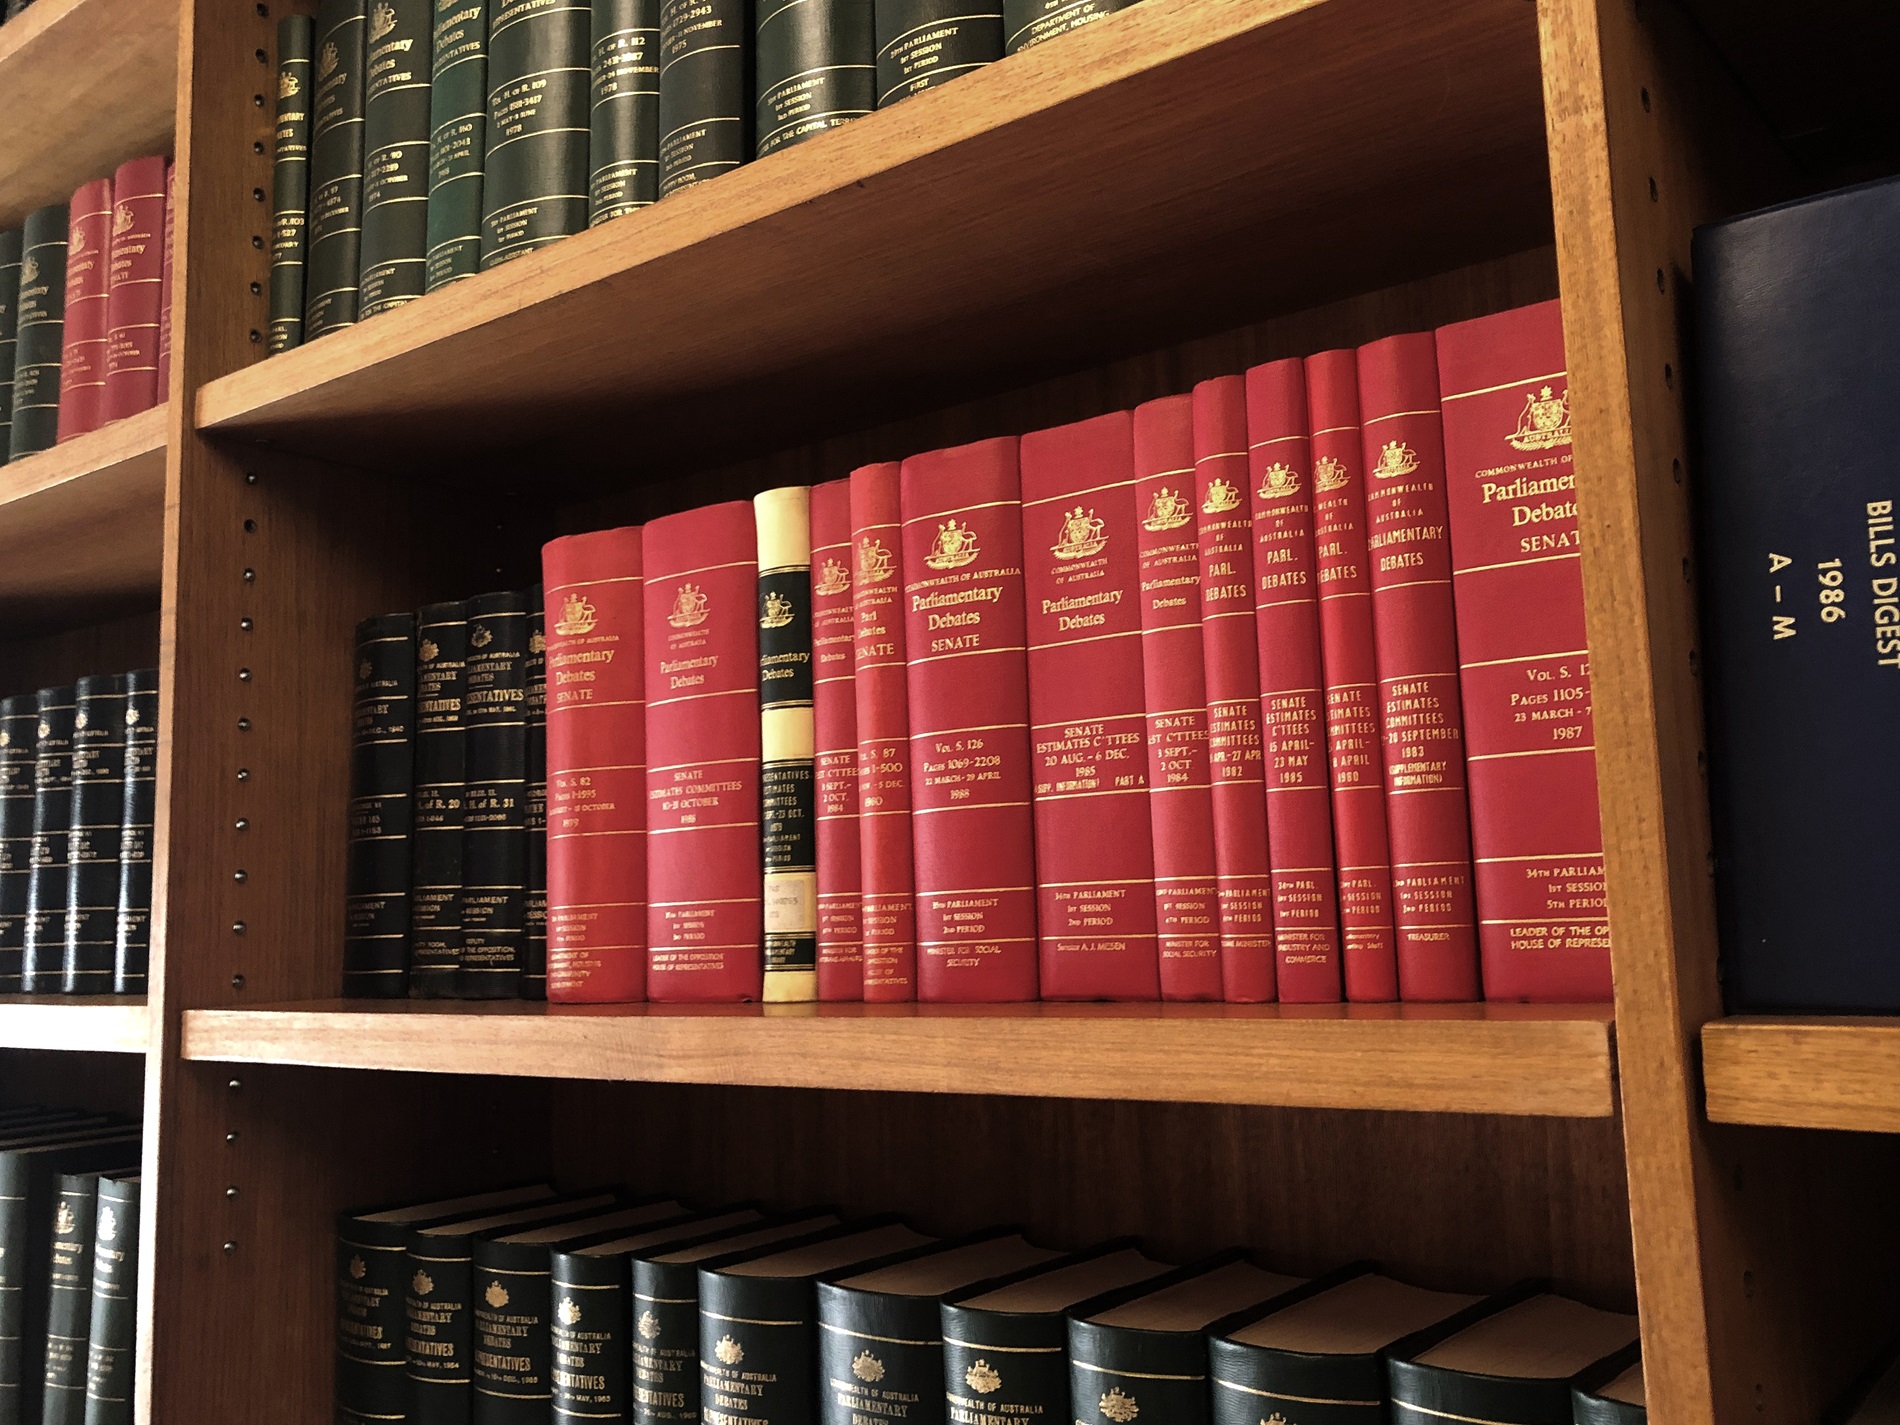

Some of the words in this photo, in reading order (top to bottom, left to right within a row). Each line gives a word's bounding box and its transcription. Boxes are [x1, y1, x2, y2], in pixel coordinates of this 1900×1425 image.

[1032, 8, 1081, 35] DEPARTMENT
[1084, 3, 1095, 13] OF
[684, 20, 722, 34] NOVEMBER
[904, 27, 958, 50] PARLIAMENT
[672, 39, 686, 54] 1975
[911, 42, 942, 59] SESSION
[914, 55, 938, 69] PERIOD
[778, 77, 825, 100] PARLIAMENT
[784, 92, 812, 107] SESSION
[796, 121, 827, 135] CAPITAL
[1475, 457, 1558, 478] COMMONWEALTH
[1561, 454, 1573, 463] OF
[1392, 498, 1401, 507] OF
[1325, 512, 1333, 521] OF
[1376, 508, 1423, 524] AUSTRALIA
[1275, 519, 1283, 528] OF
[1216, 534, 1224, 542] OF
[1260, 529, 1305, 543] AUSTRALIA
[1866, 500, 1897, 567] BILLS
[1204, 544, 1243, 556] AUSTRALIA
[1267, 549, 1298, 564] PARL.
[1319, 542, 1348, 559] PARL.
[1051, 558, 1108, 575] COMMONWEALTH
[1154, 554, 1198, 568] AUSTRALIA
[1380, 552, 1424, 572] DEBATES
[1768, 553, 1793, 573] A
[961, 573, 970, 581] OF
[973, 568, 1021, 579] AUSTRALIA
[1068, 570, 1105, 582] AUSTRALIA
[1209, 562, 1236, 578] PARL.
[1141, 575, 1201, 592] Parliamentary
[1262, 571, 1307, 590] DEBATES
[1205, 585, 1247, 602] DEBATES
[1817, 558, 1846, 623] 1986
[912, 586, 1003, 612] Parliamentary
[1042, 589, 1123, 614] Parliamentary
[1153, 597, 1186, 610] Debates
[928, 612, 980, 631] Debates
[1059, 613, 1105, 631] Debates
[1772, 615, 1797, 640] M
[1872, 577, 1900, 669] DIGEST
[931, 634, 979, 652] SENATE
[556, 671, 595, 685] Debates
[1560, 666, 1571, 678] S.
[1392, 682, 1429, 697] SENATE
[1271, 697, 1306, 710] SENATE
[1387, 697, 1440, 713] ESTIMATES
[1214, 705, 1247, 718] SENATE
[1266, 710, 1317, 725] ESTIMATES
[1514, 712, 1526, 723] 23
[1532, 708, 1573, 720] MARCH
[1155, 716, 1195, 728] SENATE
[1385, 712, 1444, 729] COMMITTEES
[1064, 724, 1104, 738] SENATE
[1402, 728, 1459, 742] SEPTEMBER
[1553, 726, 1583, 740] 1987
[967, 739, 984, 749] 126
[1037, 738, 1090, 753] ESTIMATES
[1269, 742, 1277, 753] 15
[883, 748, 896, 758] 87
[1045, 756, 1057, 766] 20
[1095, 751, 1102, 761] 6
[1105, 748, 1129, 760] DEC.
[1401, 746, 1424, 758] 1983
[948, 756, 1001, 769] 1069-2208
[1274, 757, 1284, 768] 23
[1288, 755, 1308, 767] MAY
[1341, 754, 1370, 766] APRIL
[674, 770, 702, 781] SENATE
[967, 773, 975, 782] 29
[977, 771, 1001, 781] APRIL
[1076, 766, 1095, 777] 1985
[1222, 766, 1243, 777] 1982
[1280, 772, 1303, 783] 1985
[1115, 775, 1134, 786] PART
[450, 799, 460, 809] 20
[490, 799, 500, 808] R.
[504, 798, 515, 808] 31
[681, 797, 718, 808] OCTOBER
[1407, 876, 1465, 886] PARLIAMENT
[1073, 890, 1126, 899] PARLIAMENT
[1288, 894, 1322, 902] SESSION
[1347, 892, 1381, 901] SESSION
[1414, 890, 1453, 900] SESSION
[947, 899, 998, 908] PARLIAMENT
[1080, 903, 1111, 912] SESSION
[1230, 901, 1263, 910] SESSION
[1352, 905, 1380, 914] PERIOD
[1418, 903, 1452, 912] PERIOD
[1547, 900, 1565, 909] 5TH
[953, 912, 983, 921] SESSION
[1181, 916, 1209, 924] PERIOD
[1234, 914, 1261, 923] PERIOD
[1291, 909, 1319, 918] PERIOD
[1083, 917, 1113, 926] PERIOD
[957, 925, 985, 933] PERIOD
[1510, 927, 1548, 937] LEADER
[1551, 927, 1566, 936] OF
[1569, 927, 1591, 936] THE
[1407, 933, 1450, 941] TREASURER
[975, 945, 1001, 953] SOCIAL
[1194, 940, 1209, 948] FOR
[1511, 939, 1544, 949] HOUSE
[1548, 939, 1562, 948] OF
[1285, 955, 1327, 964] COMMERCE
[507, 1315, 538, 1324] AUSTRALIA
[578, 1332, 612, 1340] AUSTRALIA
[741, 1372, 777, 1382] AUSTRALIA
[715, 1394, 748, 1410] DEBATES
[882, 1391, 919, 1402] AUSTRALIA
[837, 1392, 908, 1418] PARLIAMENTARY
[988, 1402, 997, 1412] OF
[1000, 1403, 1044, 1415] AUSTRALIA
